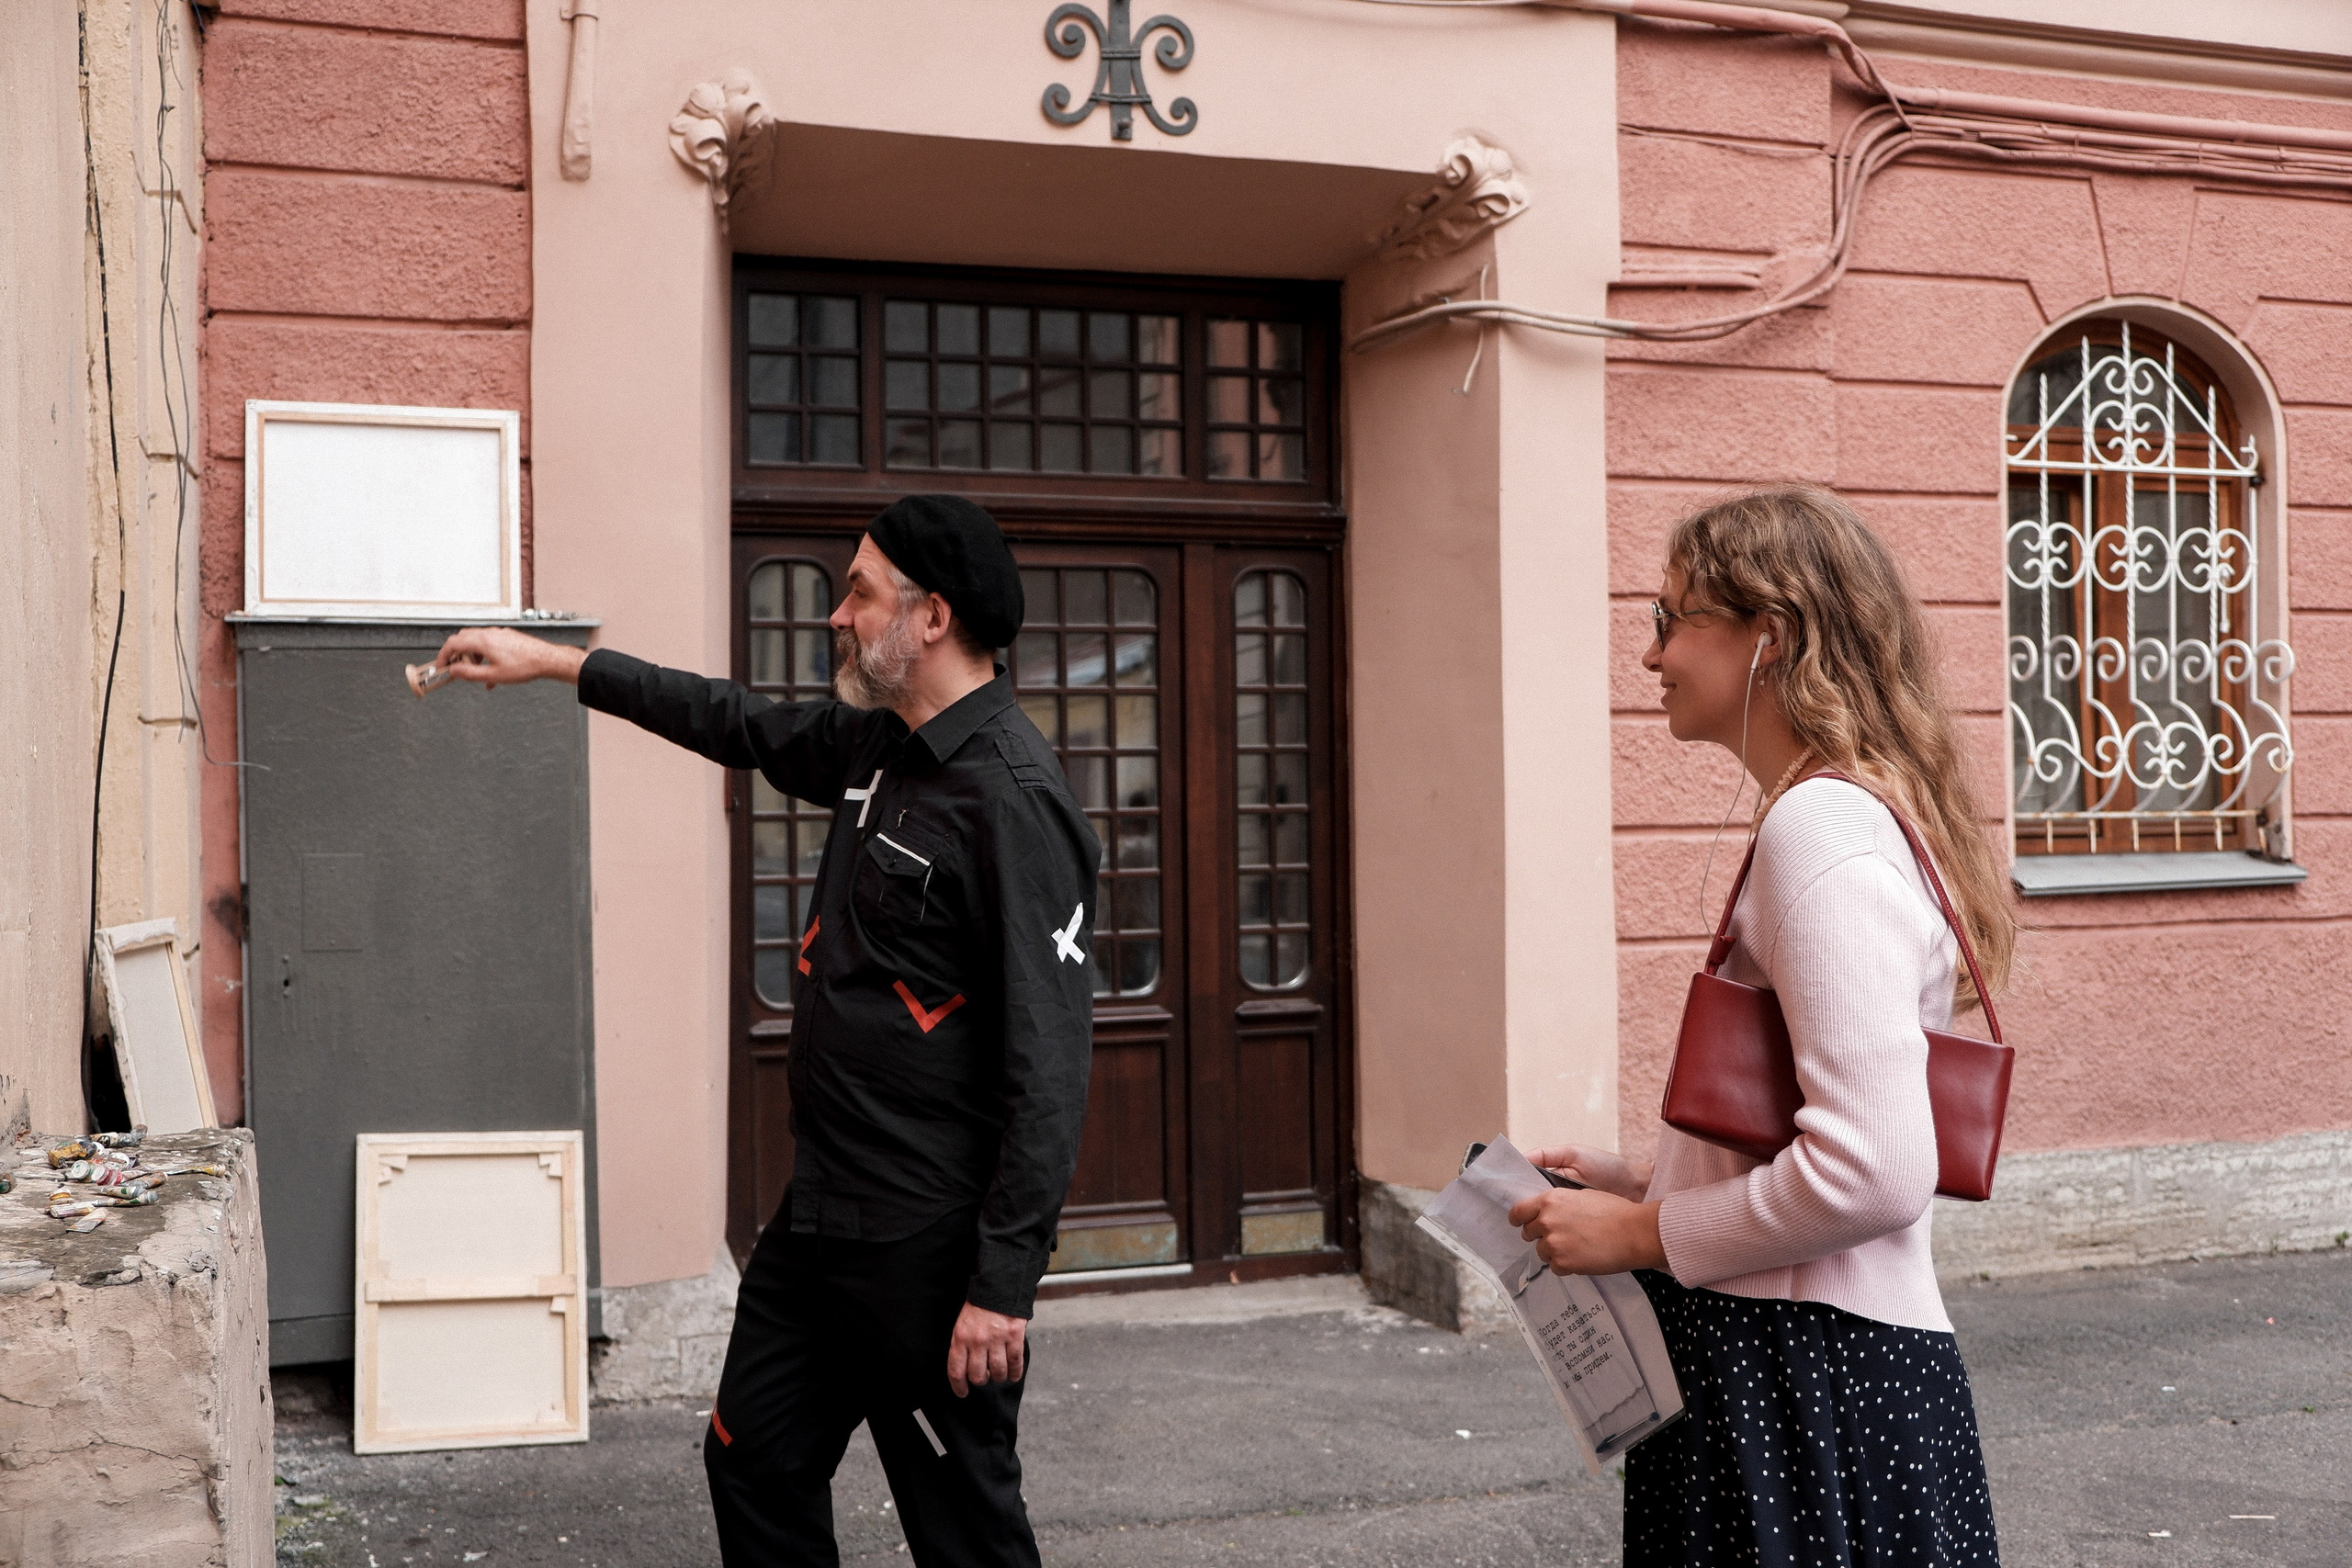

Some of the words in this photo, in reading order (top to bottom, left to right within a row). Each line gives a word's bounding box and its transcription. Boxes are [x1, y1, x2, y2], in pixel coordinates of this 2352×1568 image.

[1544, 1331, 1566, 1350] будет
[1566, 1303, 1604, 1334] казаться,
[1560, 1303, 1578, 1321] тебе
[1565, 1344, 1596, 1371] вспомни
[1596, 1333, 1614, 1348] нас,
[1566, 1340, 1577, 1352] ты
[1577, 1325, 1597, 1343] один
[1564, 1381, 1570, 1389] и
[1572, 1371, 1582, 1383] мы
[1583, 1351, 1612, 1375] придем.
